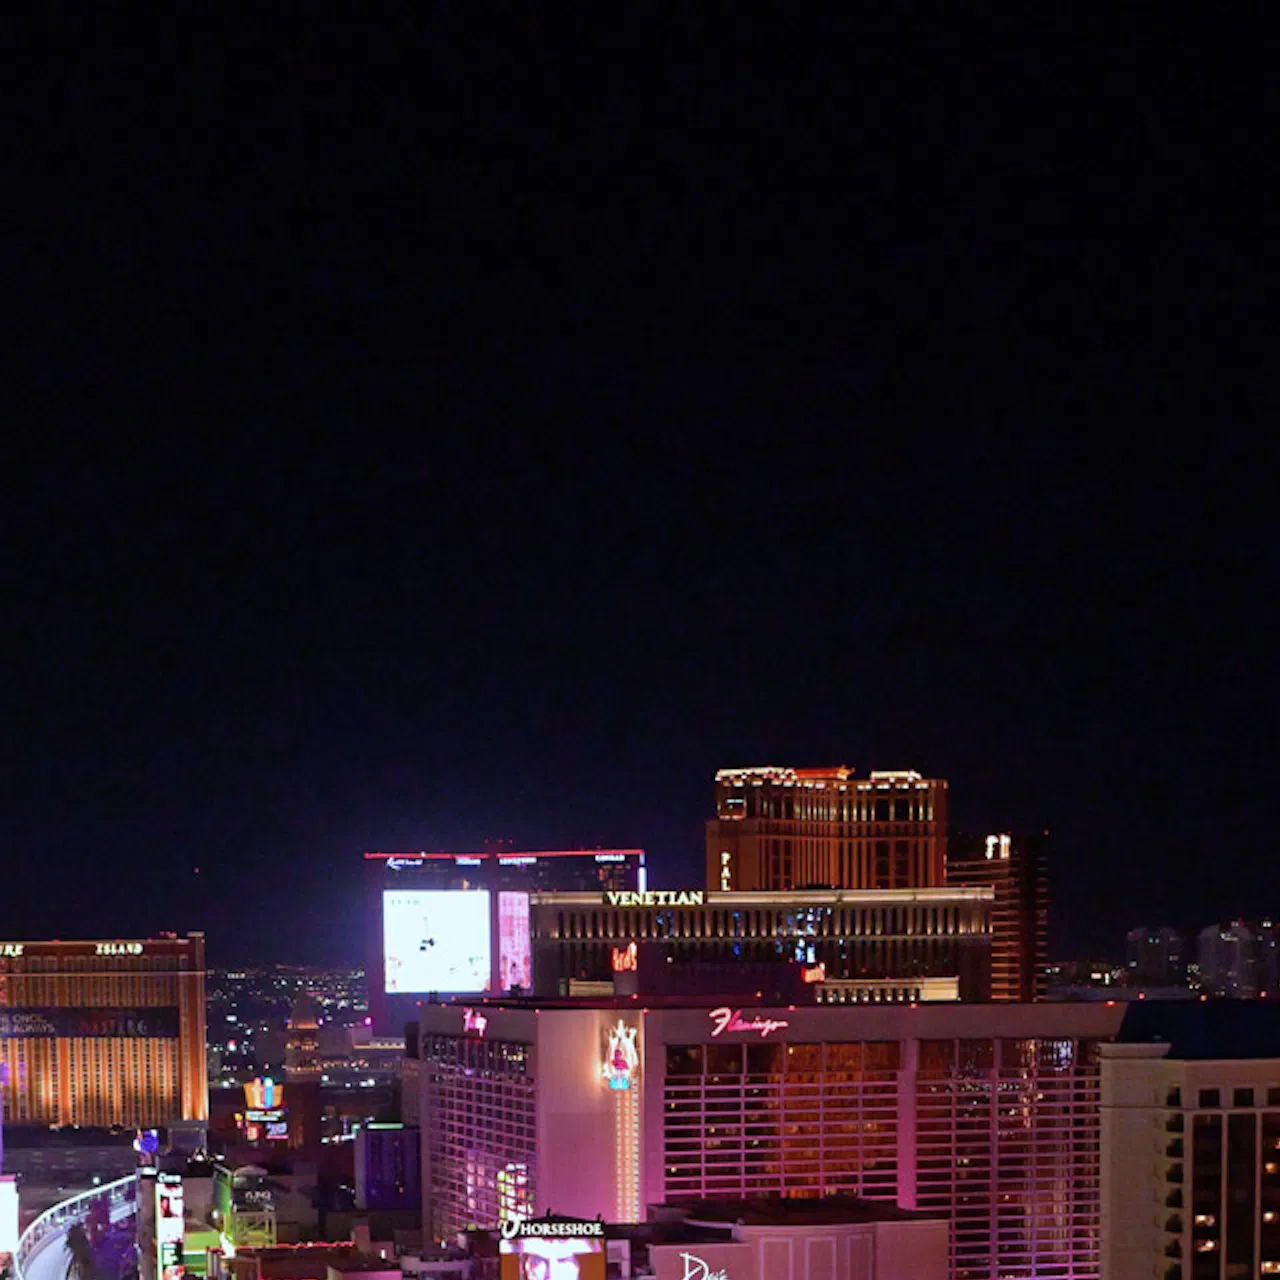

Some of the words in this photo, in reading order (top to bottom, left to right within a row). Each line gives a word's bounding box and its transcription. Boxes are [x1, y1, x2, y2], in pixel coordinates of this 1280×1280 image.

[607, 890, 704, 905] VENETIAN
[94, 943, 144, 956] ISLAND
[520, 1223, 604, 1236] HORSESHOE
